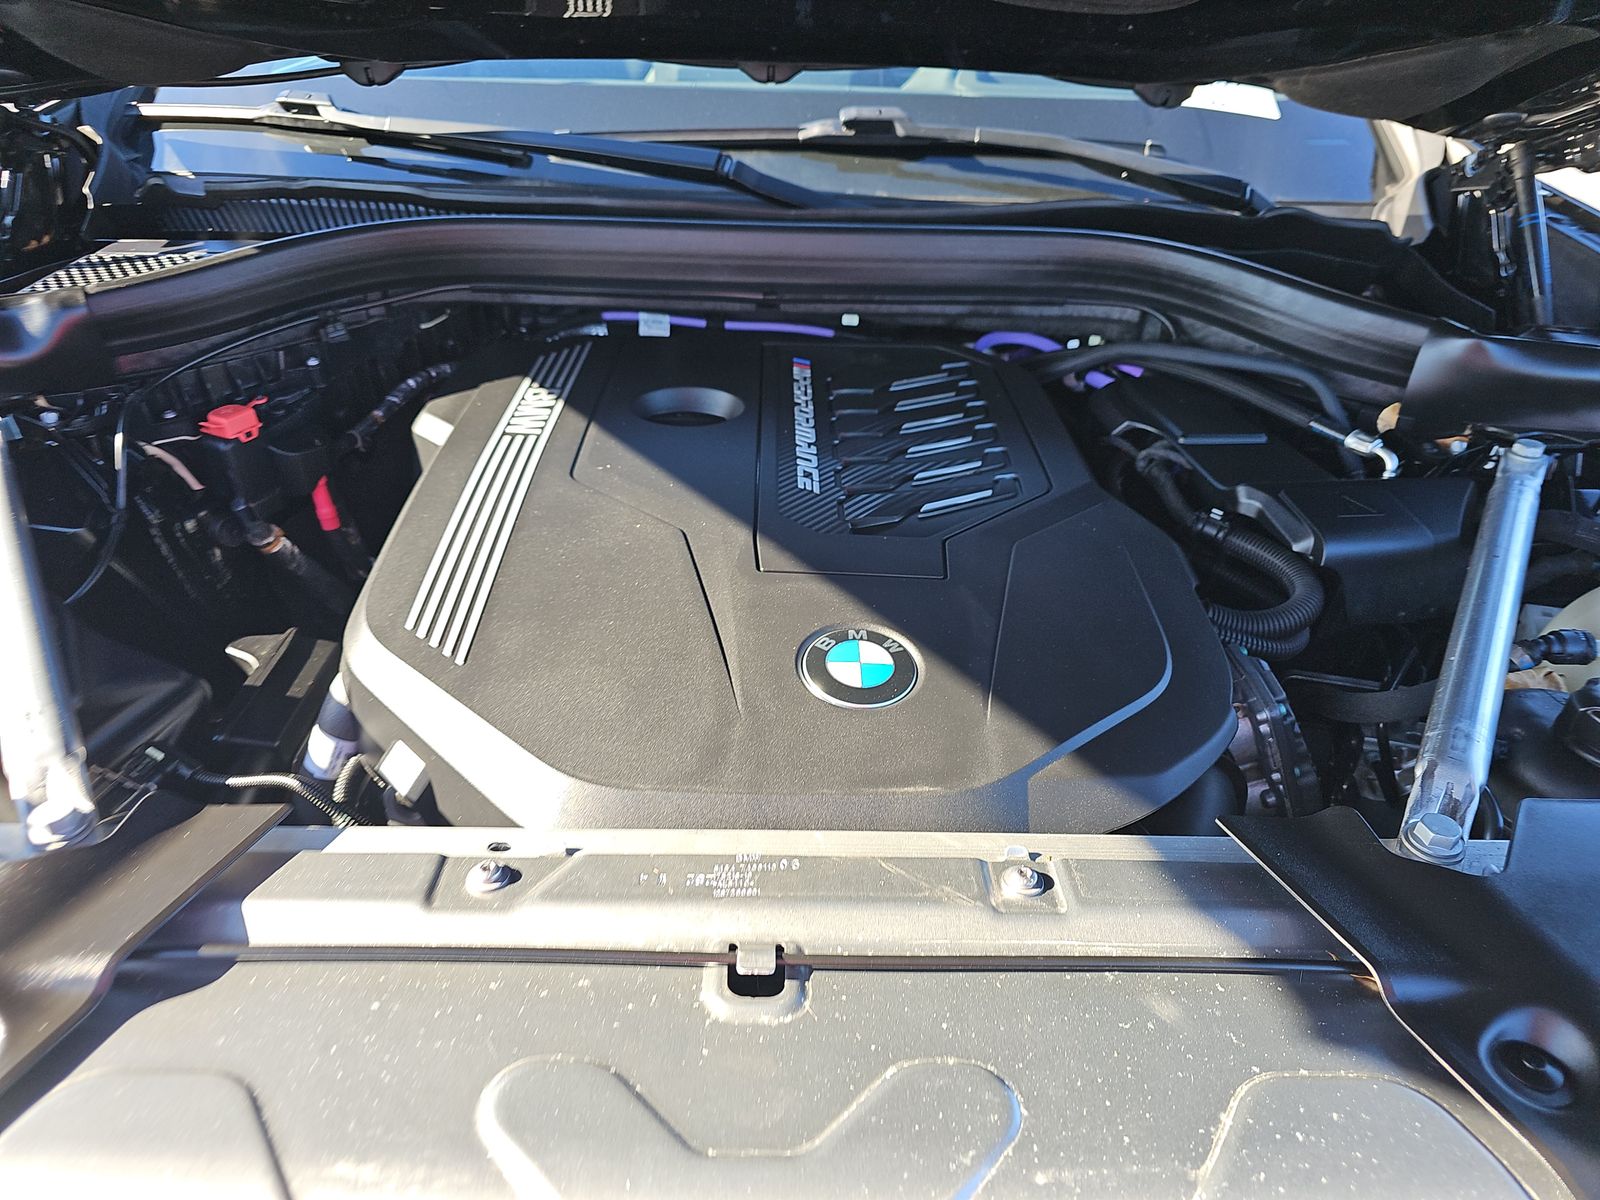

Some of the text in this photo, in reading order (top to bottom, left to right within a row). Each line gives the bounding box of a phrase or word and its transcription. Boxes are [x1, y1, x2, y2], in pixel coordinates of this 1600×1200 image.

[504, 387, 562, 435] BMW
[793, 373, 821, 495] PERFORMANCE
[814, 629, 904, 653] BMW
